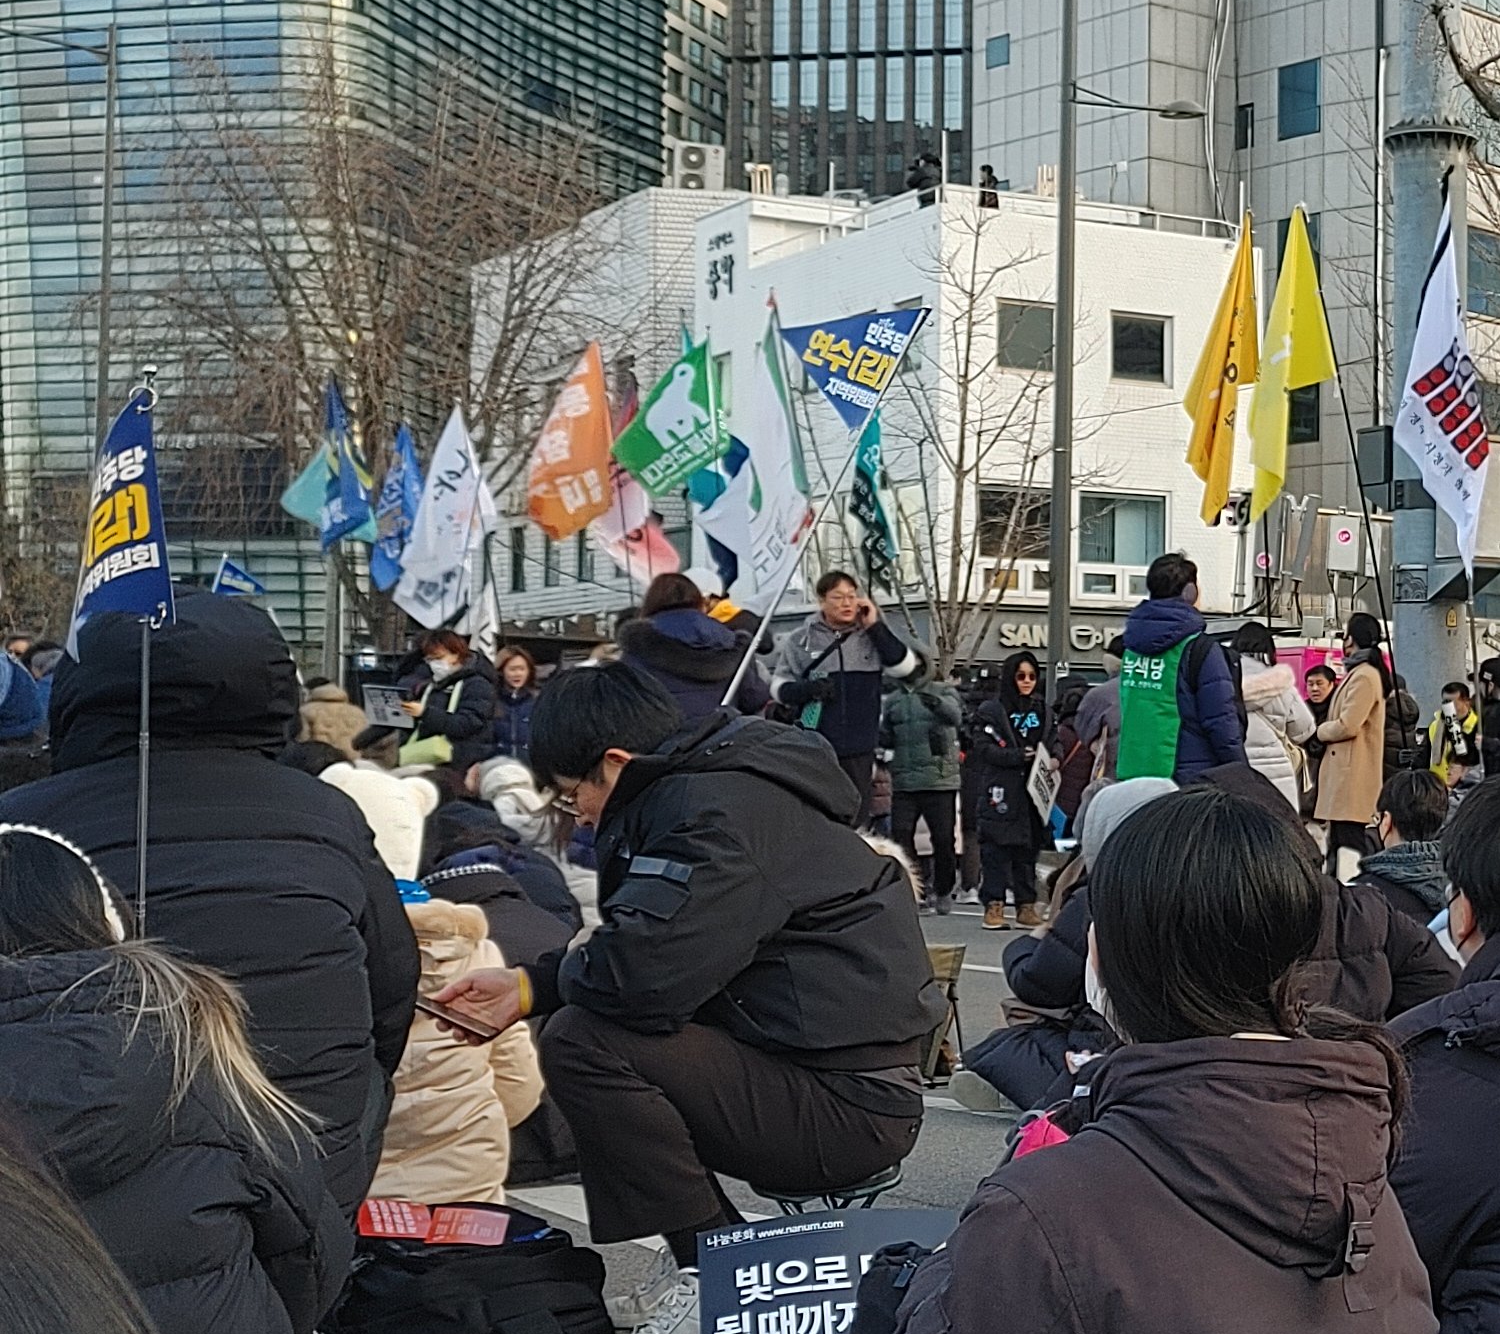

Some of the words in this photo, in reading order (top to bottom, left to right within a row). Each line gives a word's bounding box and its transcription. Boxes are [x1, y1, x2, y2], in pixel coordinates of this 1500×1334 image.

[1122, 655, 1166, 680] 녹색당
[706, 1228, 755, 1248] 나눔문화
[757, 1219, 844, 1239] www.nanum.com
[735, 1255, 852, 1305] 빛으로
